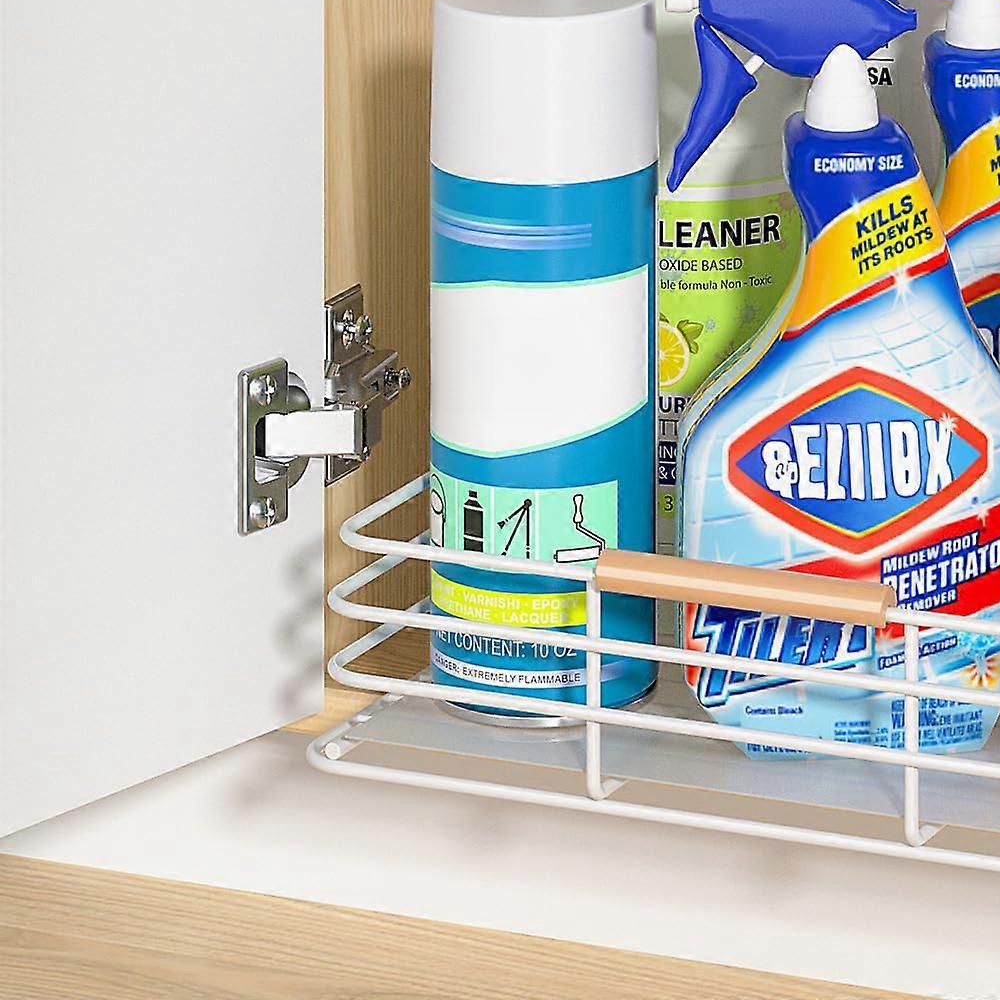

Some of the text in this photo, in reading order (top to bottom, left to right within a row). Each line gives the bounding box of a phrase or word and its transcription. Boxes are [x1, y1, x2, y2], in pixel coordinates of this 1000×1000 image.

[814, 155, 904, 173] ECONOMY SIZE
[856, 195, 914, 238] KILLS
[852, 208, 929, 260] MILDEW AT
[858, 226, 934, 274] ITS ROOTS
[659, 257, 743, 272] OXIDE BASED
[678, 279, 718, 291] formula
[883, 532, 979, 573] MILDEW ROOT
[454, 632, 526, 659] CONTENT:
[531, 642, 549, 659] 10
[462, 666, 516, 684] EXTREMELY
[518, 672, 581, 685] FLAMMABLE
